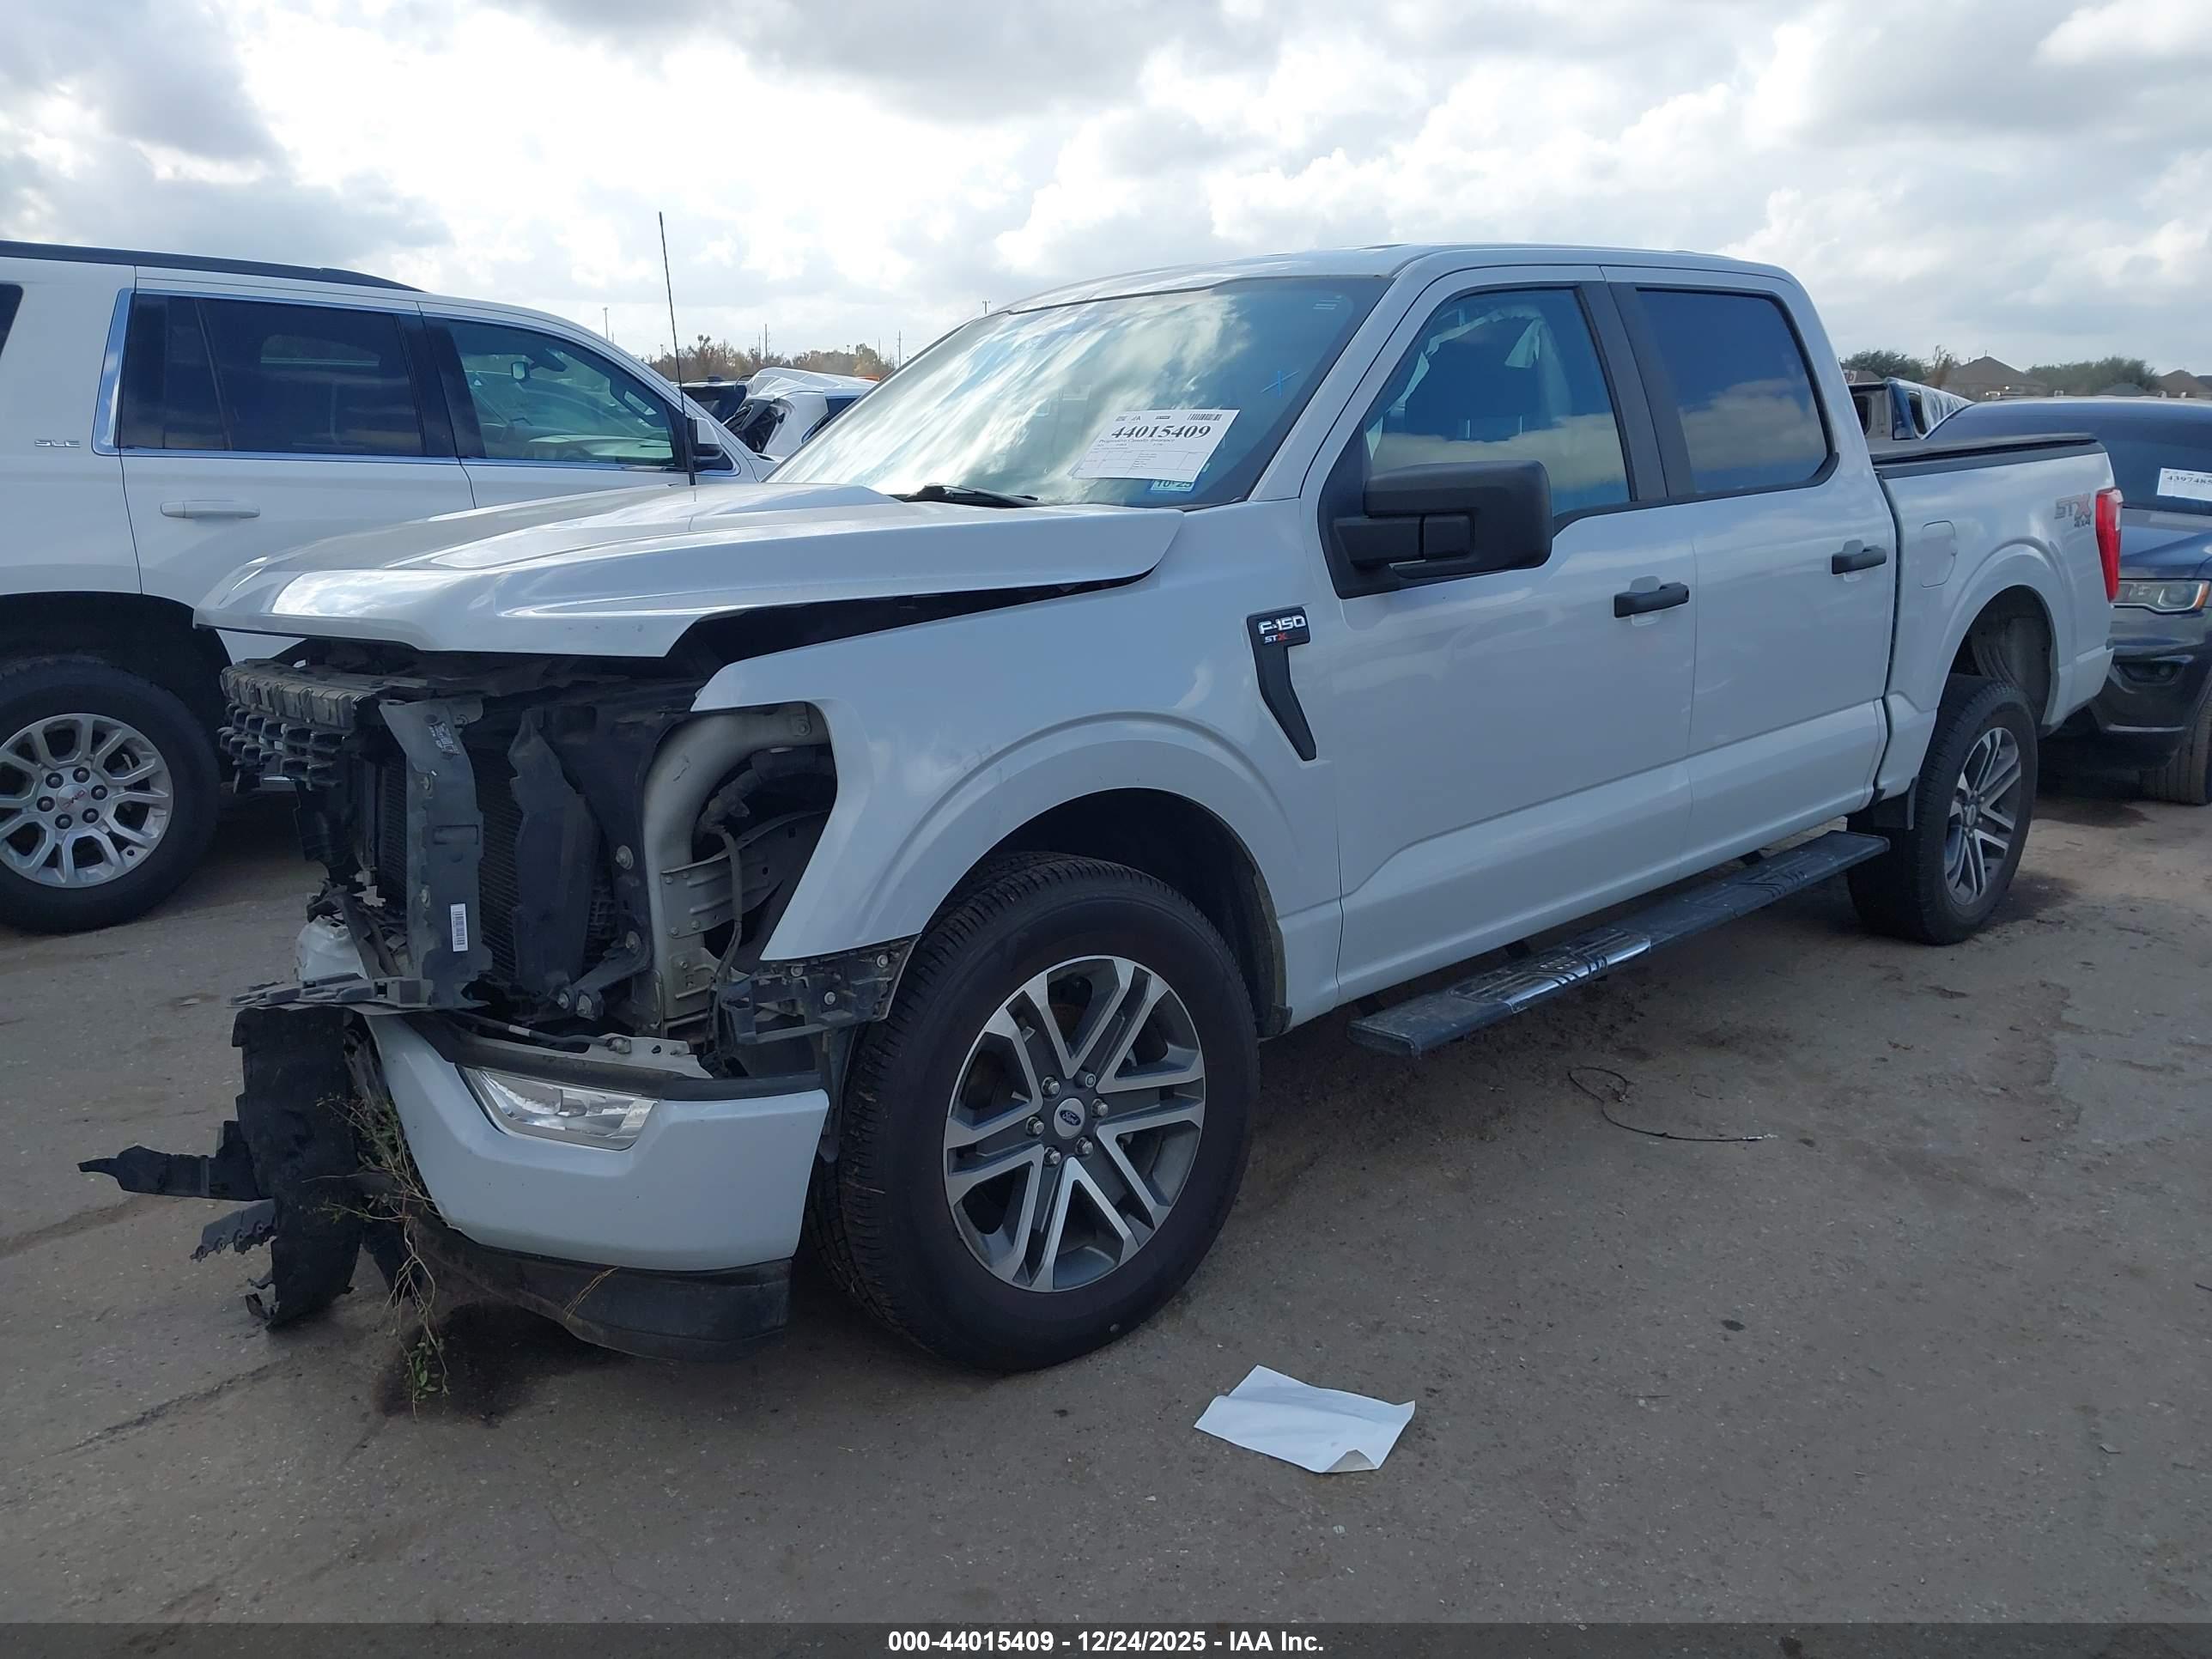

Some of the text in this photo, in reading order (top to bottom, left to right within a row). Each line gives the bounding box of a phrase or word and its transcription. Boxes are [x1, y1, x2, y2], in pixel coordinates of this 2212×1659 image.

[1111, 425, 1211, 439] 44015409
[1258, 615, 1306, 635] F-150
[1264, 632, 1288, 644] STX
